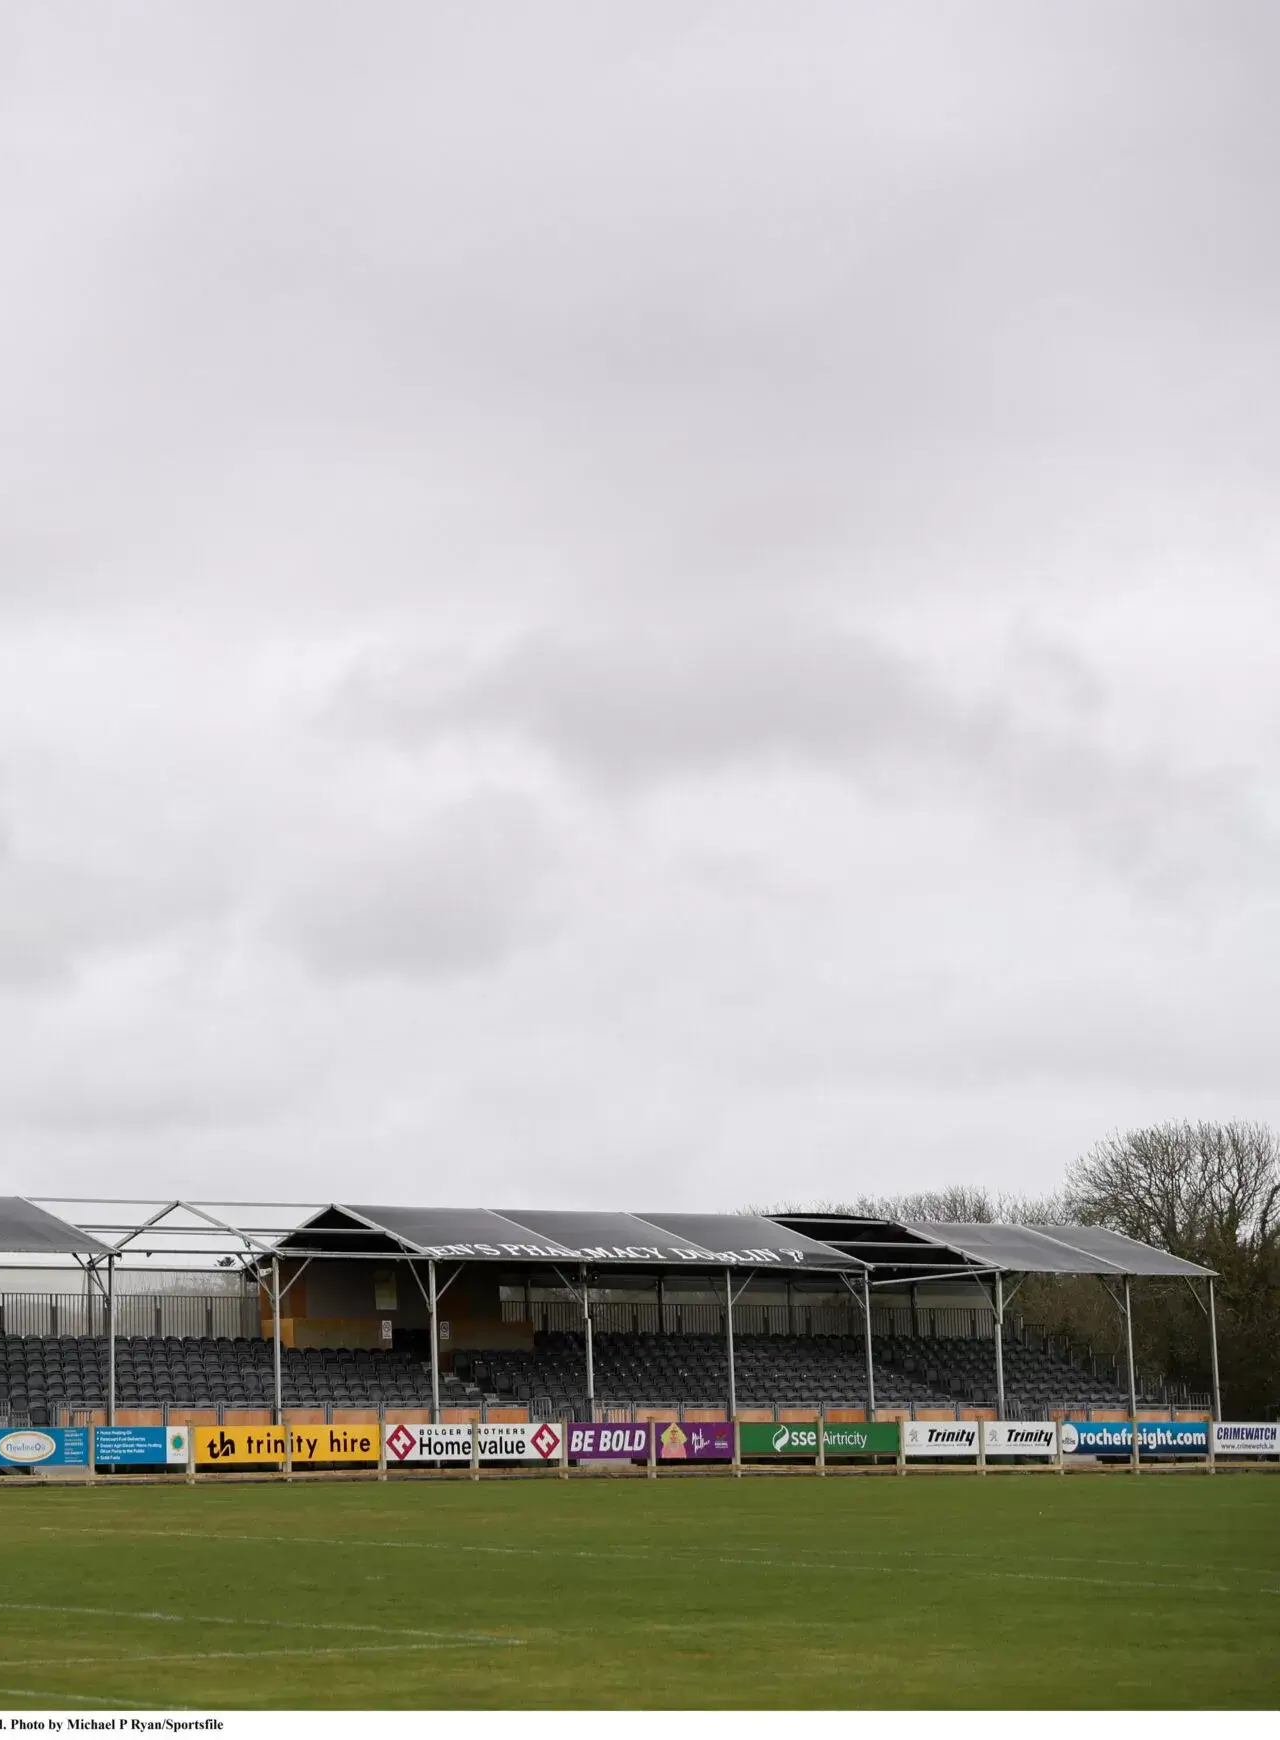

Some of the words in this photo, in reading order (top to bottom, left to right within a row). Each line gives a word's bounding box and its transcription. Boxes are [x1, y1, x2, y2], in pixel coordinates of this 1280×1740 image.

[419, 1428, 462, 1436] BOLGER
[570, 1430, 595, 1452] BE
[598, 1429, 647, 1452] BOLD
[791, 1431, 817, 1446] sse
[822, 1431, 868, 1449] Airtricity
[927, 1429, 976, 1447] Trinity
[1006, 1429, 1054, 1447] Trinity
[1079, 1427, 1206, 1450] rochefreight.com
[1216, 1426, 1277, 1440] CRIMEWATCH
[247, 1432, 318, 1459] trinity
[329, 1429, 371, 1453] hire
